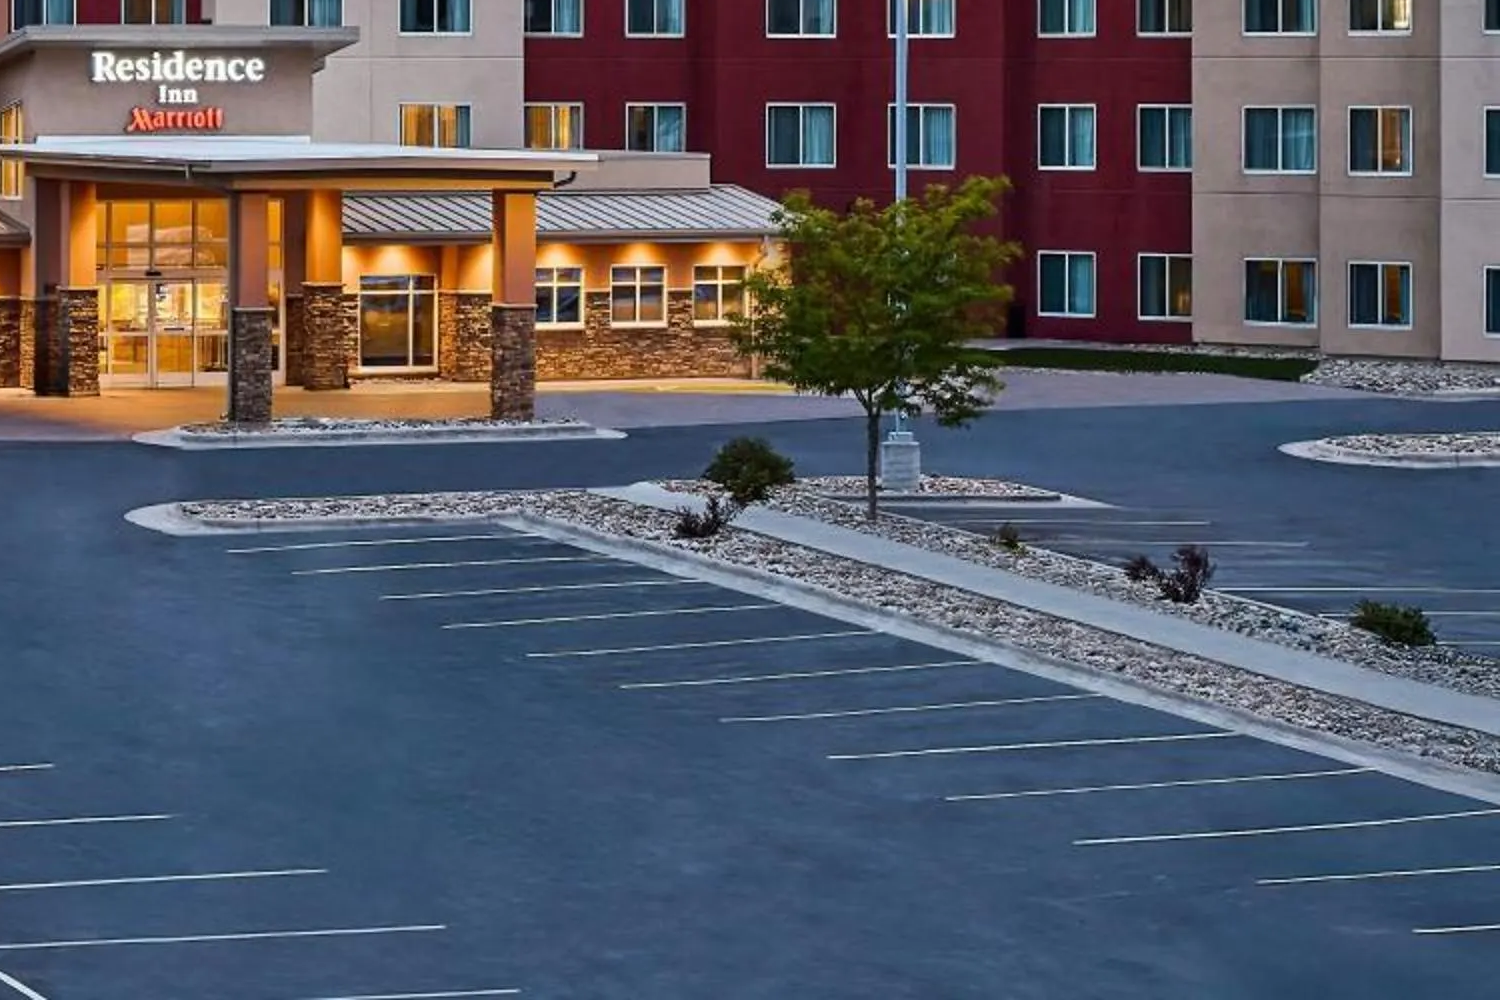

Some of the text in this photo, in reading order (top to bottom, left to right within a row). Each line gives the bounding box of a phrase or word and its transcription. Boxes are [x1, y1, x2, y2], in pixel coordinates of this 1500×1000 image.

[92, 51, 265, 81] Residence
[158, 85, 199, 103] Inn
[126, 107, 224, 132] Marriott
